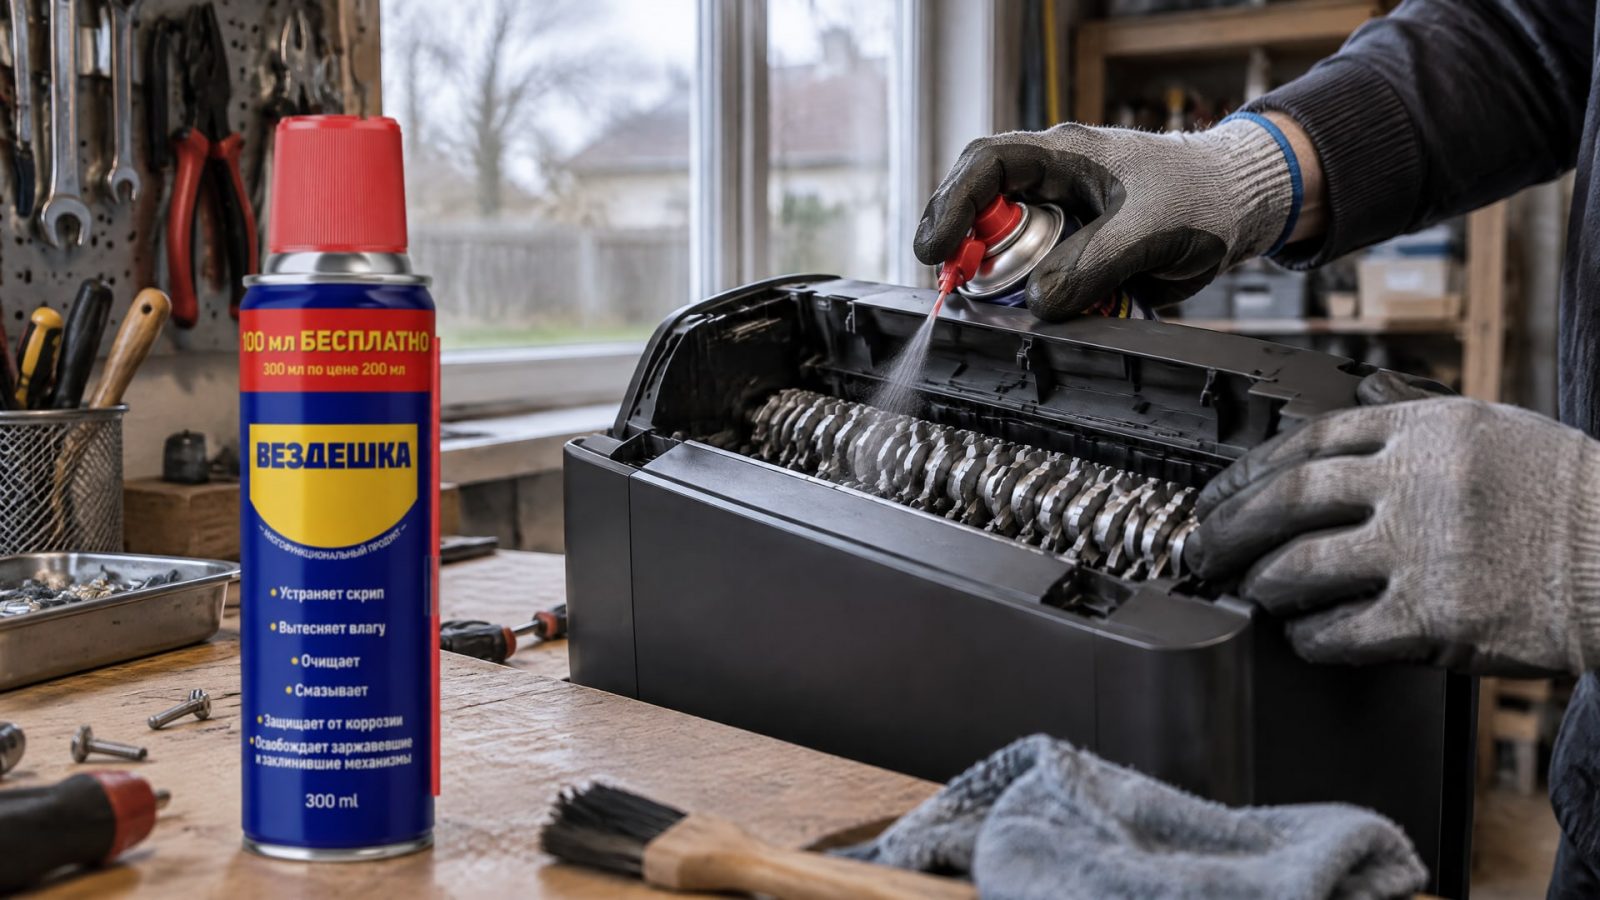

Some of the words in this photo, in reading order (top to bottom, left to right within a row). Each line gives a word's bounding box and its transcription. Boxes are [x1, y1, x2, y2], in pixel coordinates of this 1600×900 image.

[243, 331, 265, 352] 100
[268, 335, 295, 352] мл
[300, 330, 429, 352] БЕСПЛАТНО
[263, 362, 285, 376] 300
[287, 363, 304, 376] мл
[307, 364, 323, 376] по
[326, 364, 359, 377] цене
[361, 362, 387, 376] 200
[389, 363, 406, 376] мл
[256, 442, 412, 469] ВЕЗДЕШКА
[279, 586, 344, 603] Устраняет
[346, 588, 384, 603] скрип
[278, 621, 346, 634] Вытесняет
[349, 623, 386, 637] влагу
[301, 654, 360, 670] Очищает
[295, 683, 368, 697] Смазывает
[264, 713, 325, 731] Защищает
[327, 718, 342, 729] от
[345, 715, 403, 732] коррозии
[255, 735, 328, 755] Освобождает
[331, 737, 413, 755] заржавевшие
[262, 756, 342, 770] заклинившие
[344, 753, 412, 770] механизмы
[305, 793, 336, 808] 300
[339, 793, 358, 808] ml
